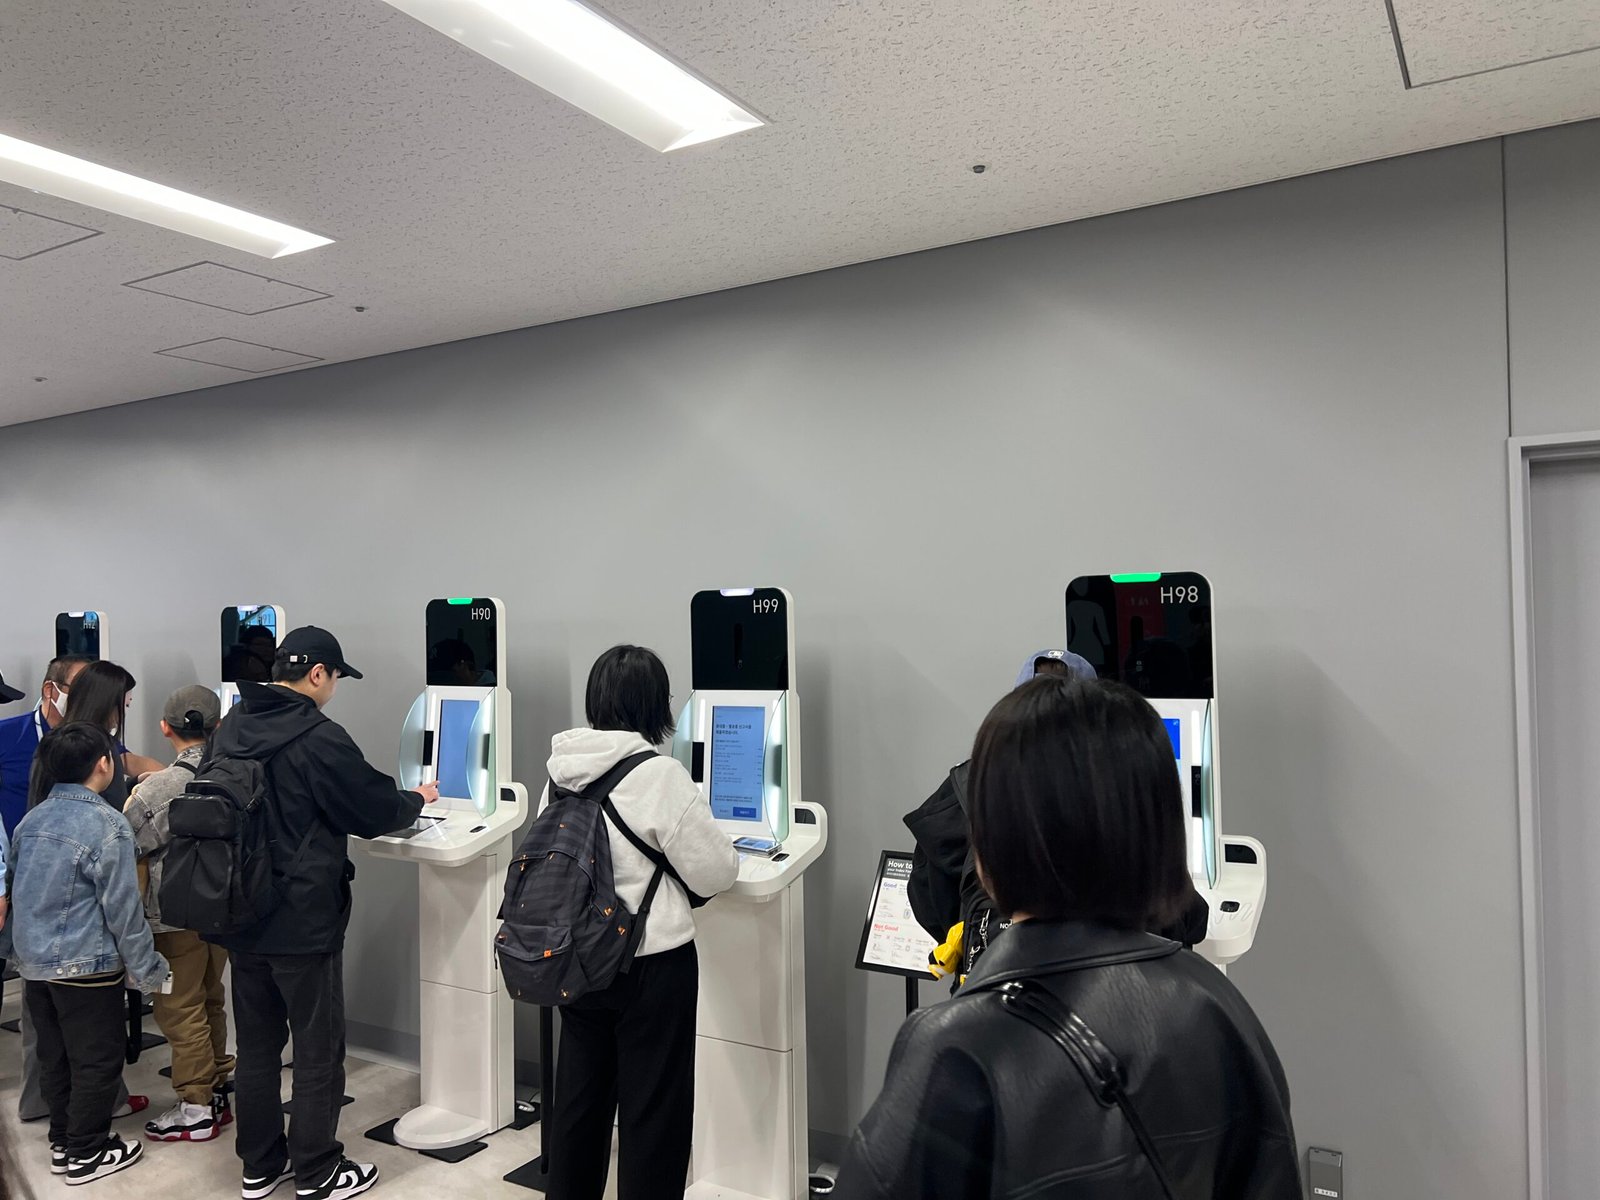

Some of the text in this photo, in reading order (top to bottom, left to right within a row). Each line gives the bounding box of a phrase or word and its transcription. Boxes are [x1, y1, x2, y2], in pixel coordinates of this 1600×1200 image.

[1160, 585, 1199, 604] H98
[753, 598, 779, 614] H99
[471, 607, 491, 620] H90
[888, 860, 913, 870] How to
